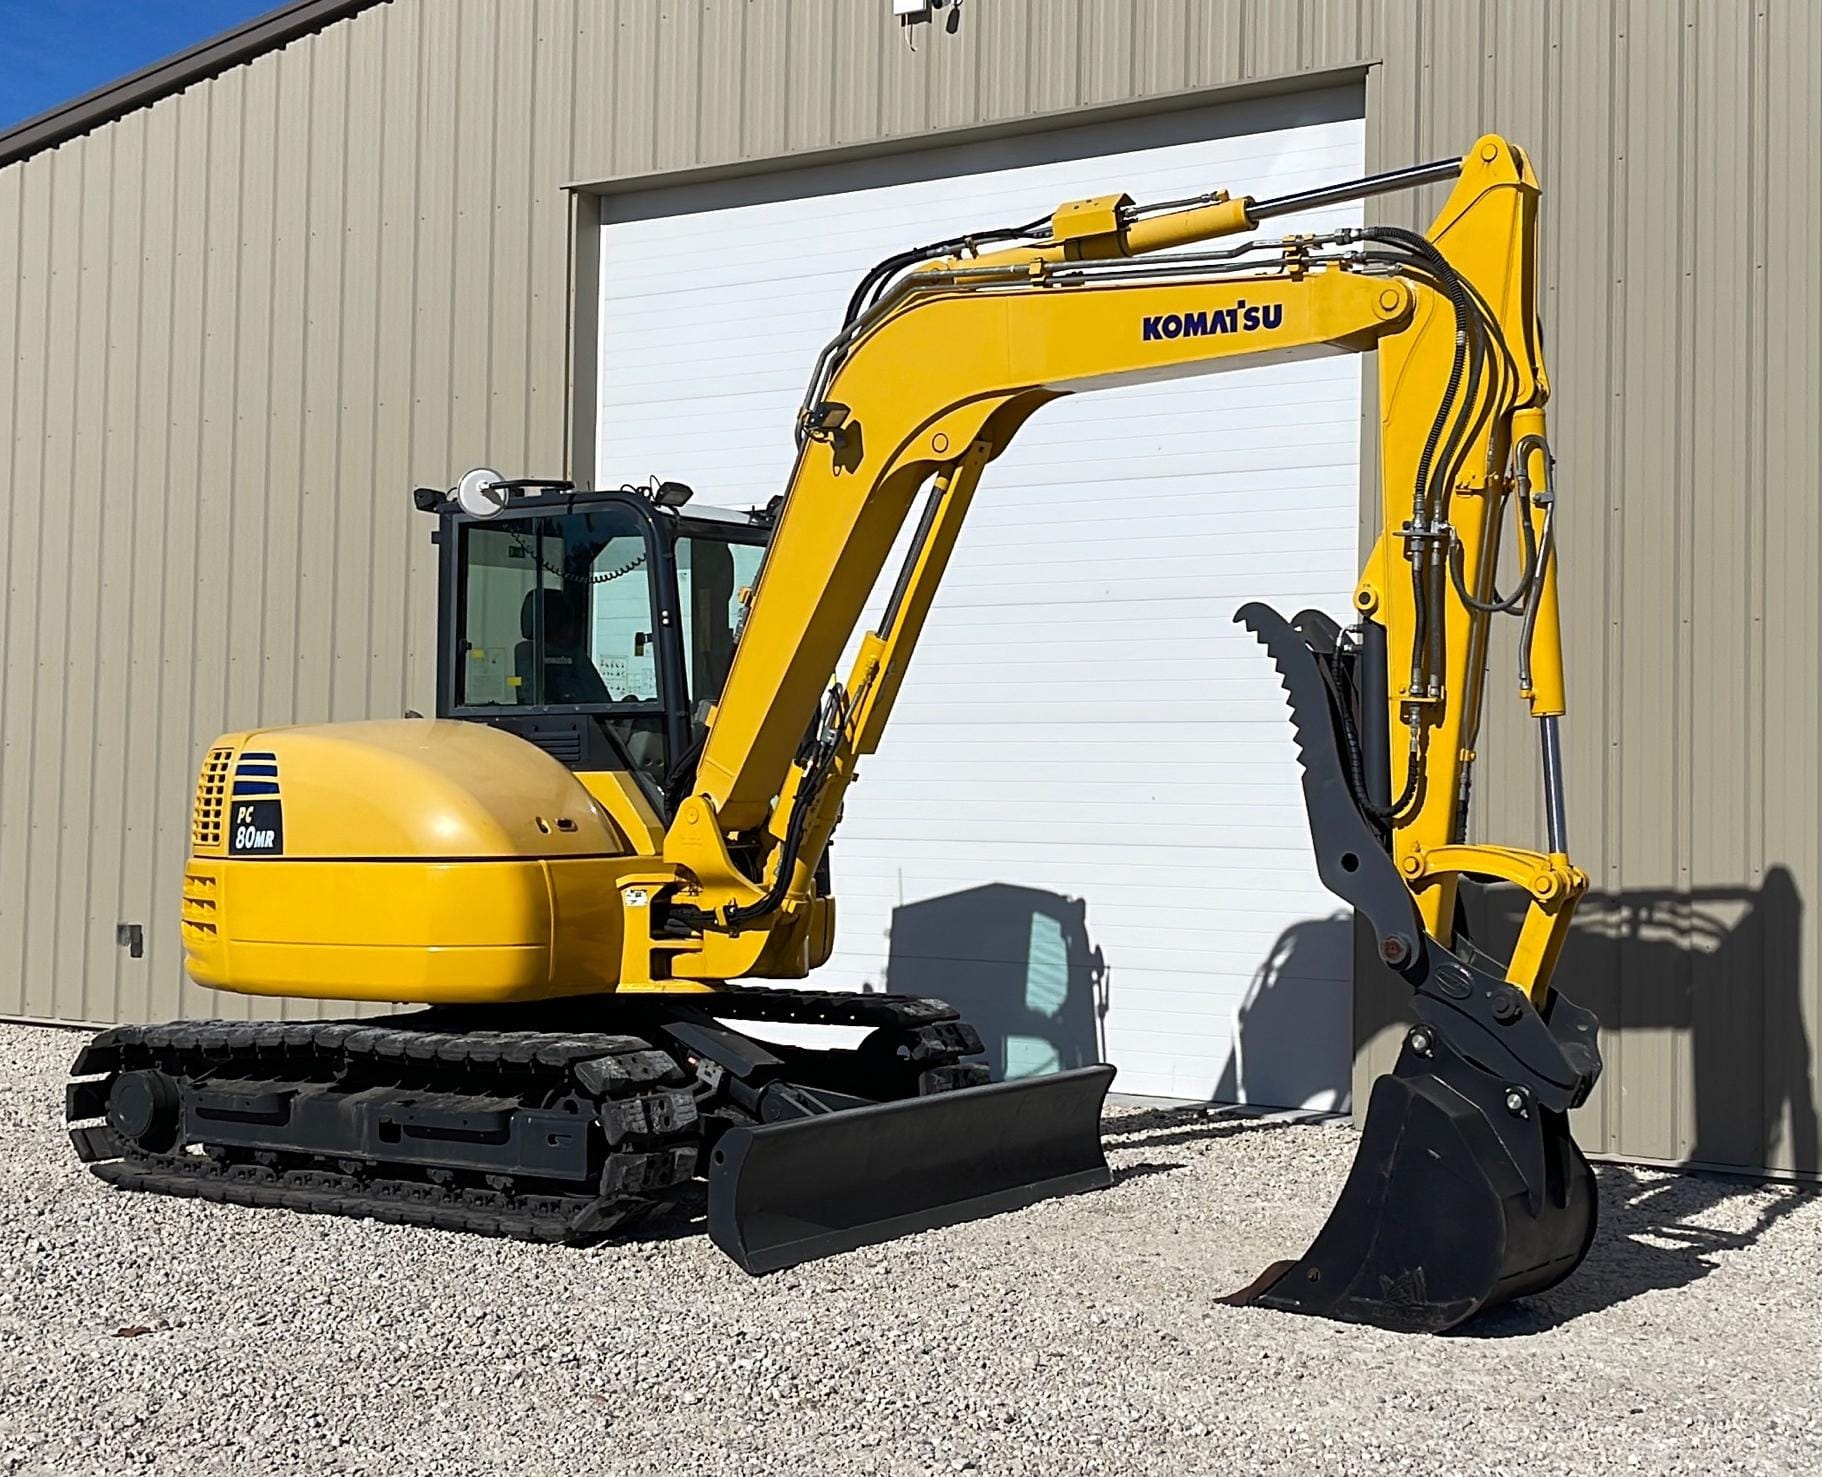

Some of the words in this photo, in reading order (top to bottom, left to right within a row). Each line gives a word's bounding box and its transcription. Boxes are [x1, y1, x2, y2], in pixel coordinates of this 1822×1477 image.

[1143, 300, 1283, 341] KOMATSU
[236, 806, 255, 824] PC
[235, 825, 275, 849] 80MR
